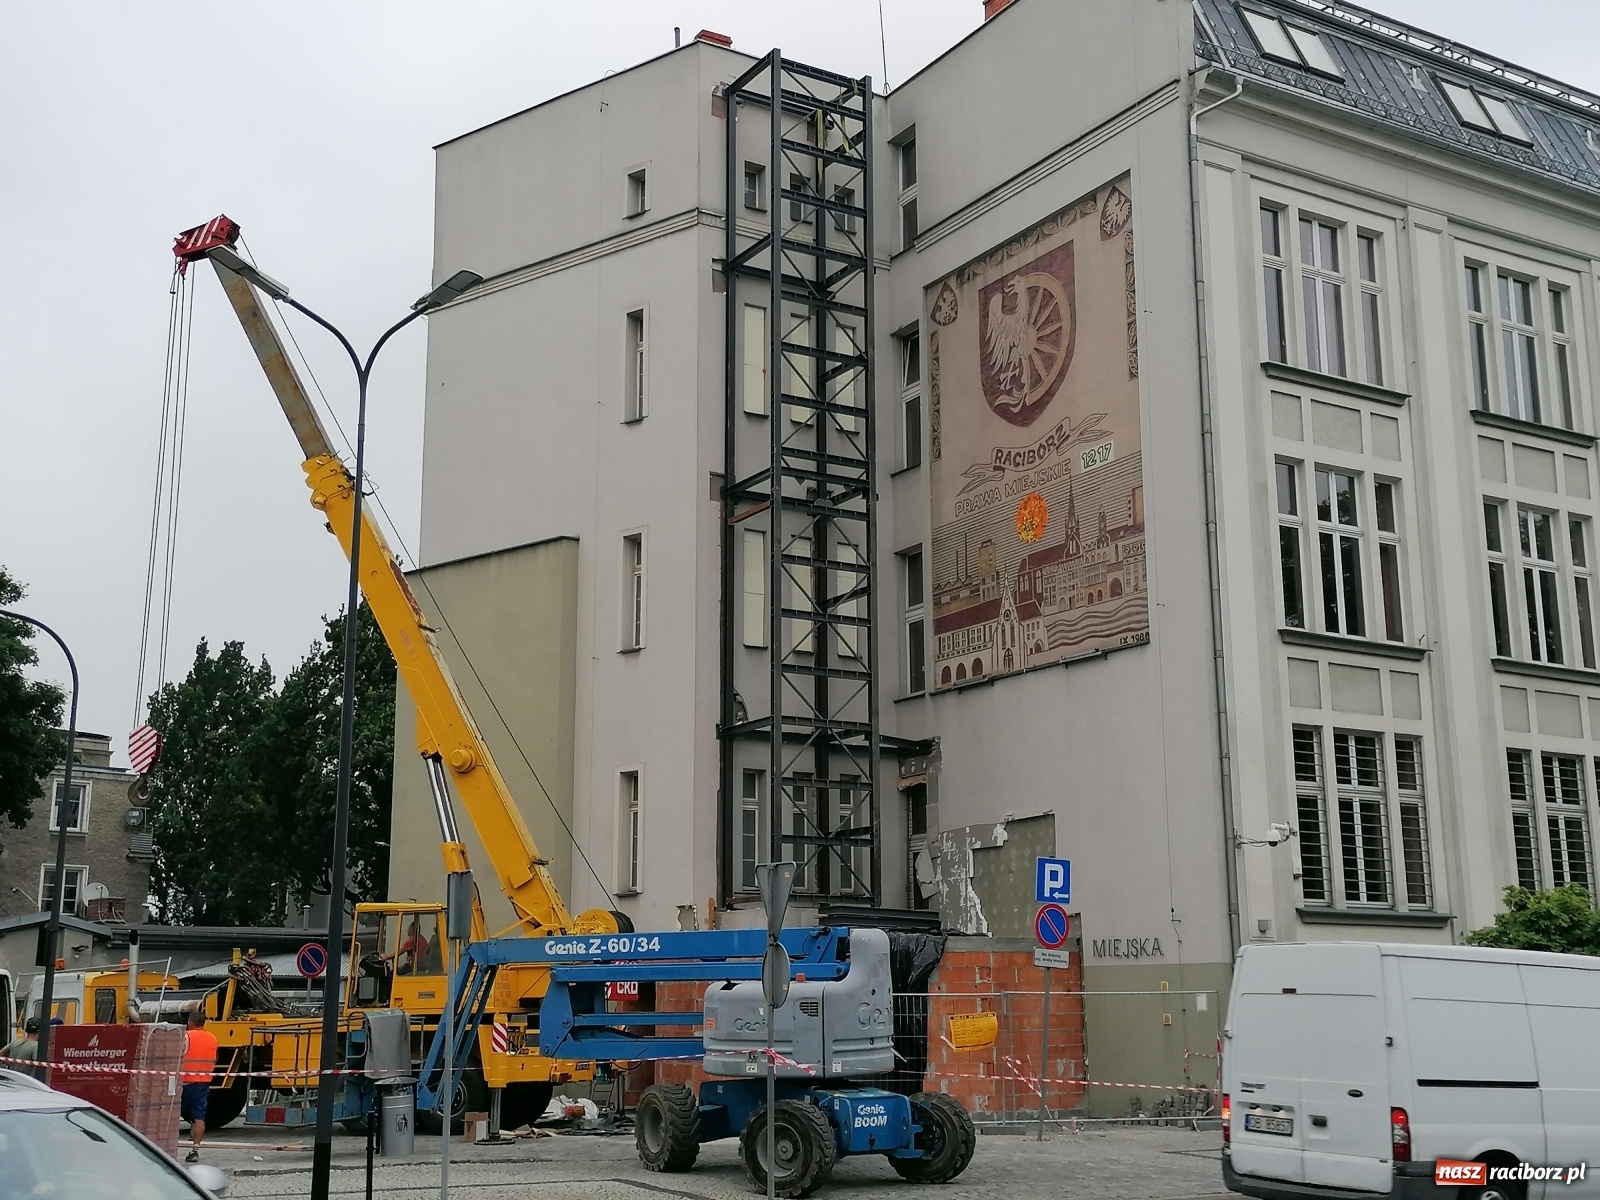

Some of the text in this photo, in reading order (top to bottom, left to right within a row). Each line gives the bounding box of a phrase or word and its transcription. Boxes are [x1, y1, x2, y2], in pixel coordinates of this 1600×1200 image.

[954, 442, 1112, 517] PRAWA MIEJSKIE 1217
[1119, 635, 1129, 645] IX
[1044, 863, 1064, 897] P
[544, 936, 661, 955] Genie Z-60/34
[1092, 937, 1164, 959] MIEJSKA
[63, 1047, 128, 1059] Wienerberger
[857, 1104, 886, 1115] Genie
[854, 1115, 888, 1128] BOOM
